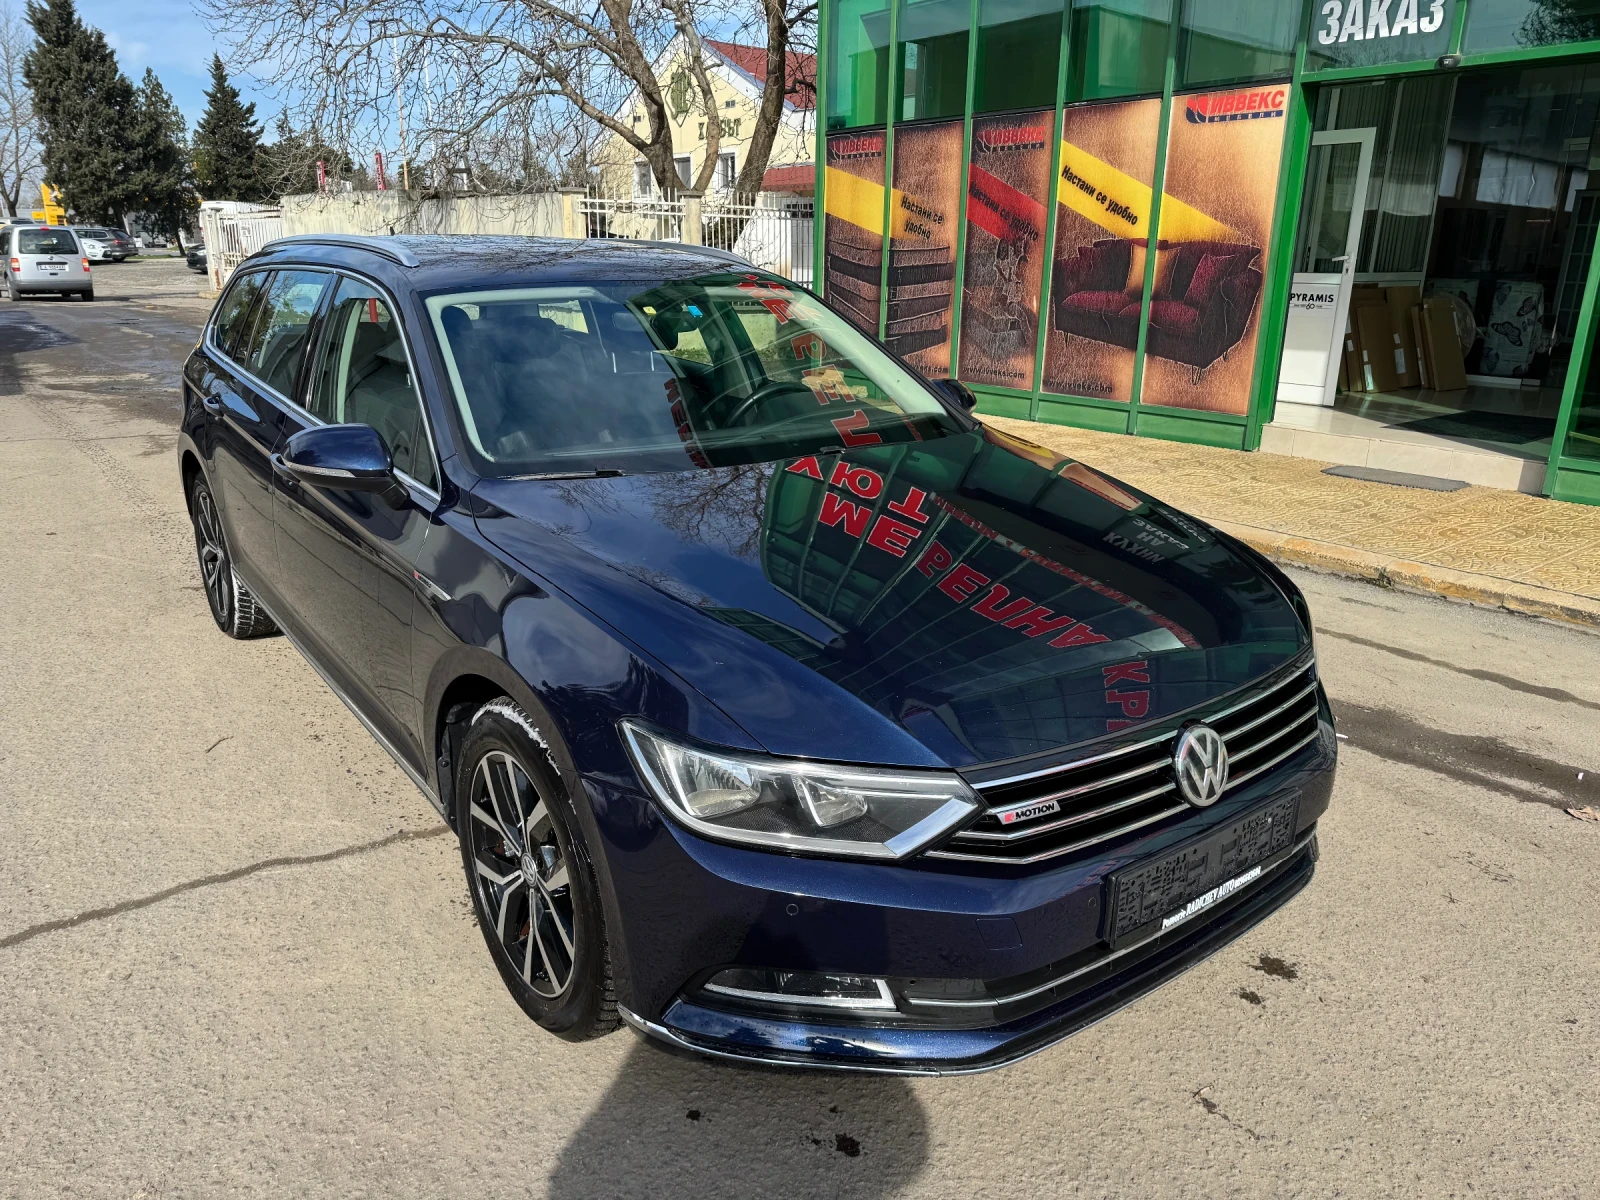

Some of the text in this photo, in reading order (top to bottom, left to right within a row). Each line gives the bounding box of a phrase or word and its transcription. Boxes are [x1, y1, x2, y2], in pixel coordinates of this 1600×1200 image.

[1318, 0, 1445, 45] ЗАКАЗ
[901, 195, 945, 225] Настани се
[969, 181, 1039, 242] Настани се удобно
[1061, 165, 1138, 226] Настани се удобно
[904, 217, 931, 240] удобно
[1289, 292, 1335, 303] PYRAMIS
